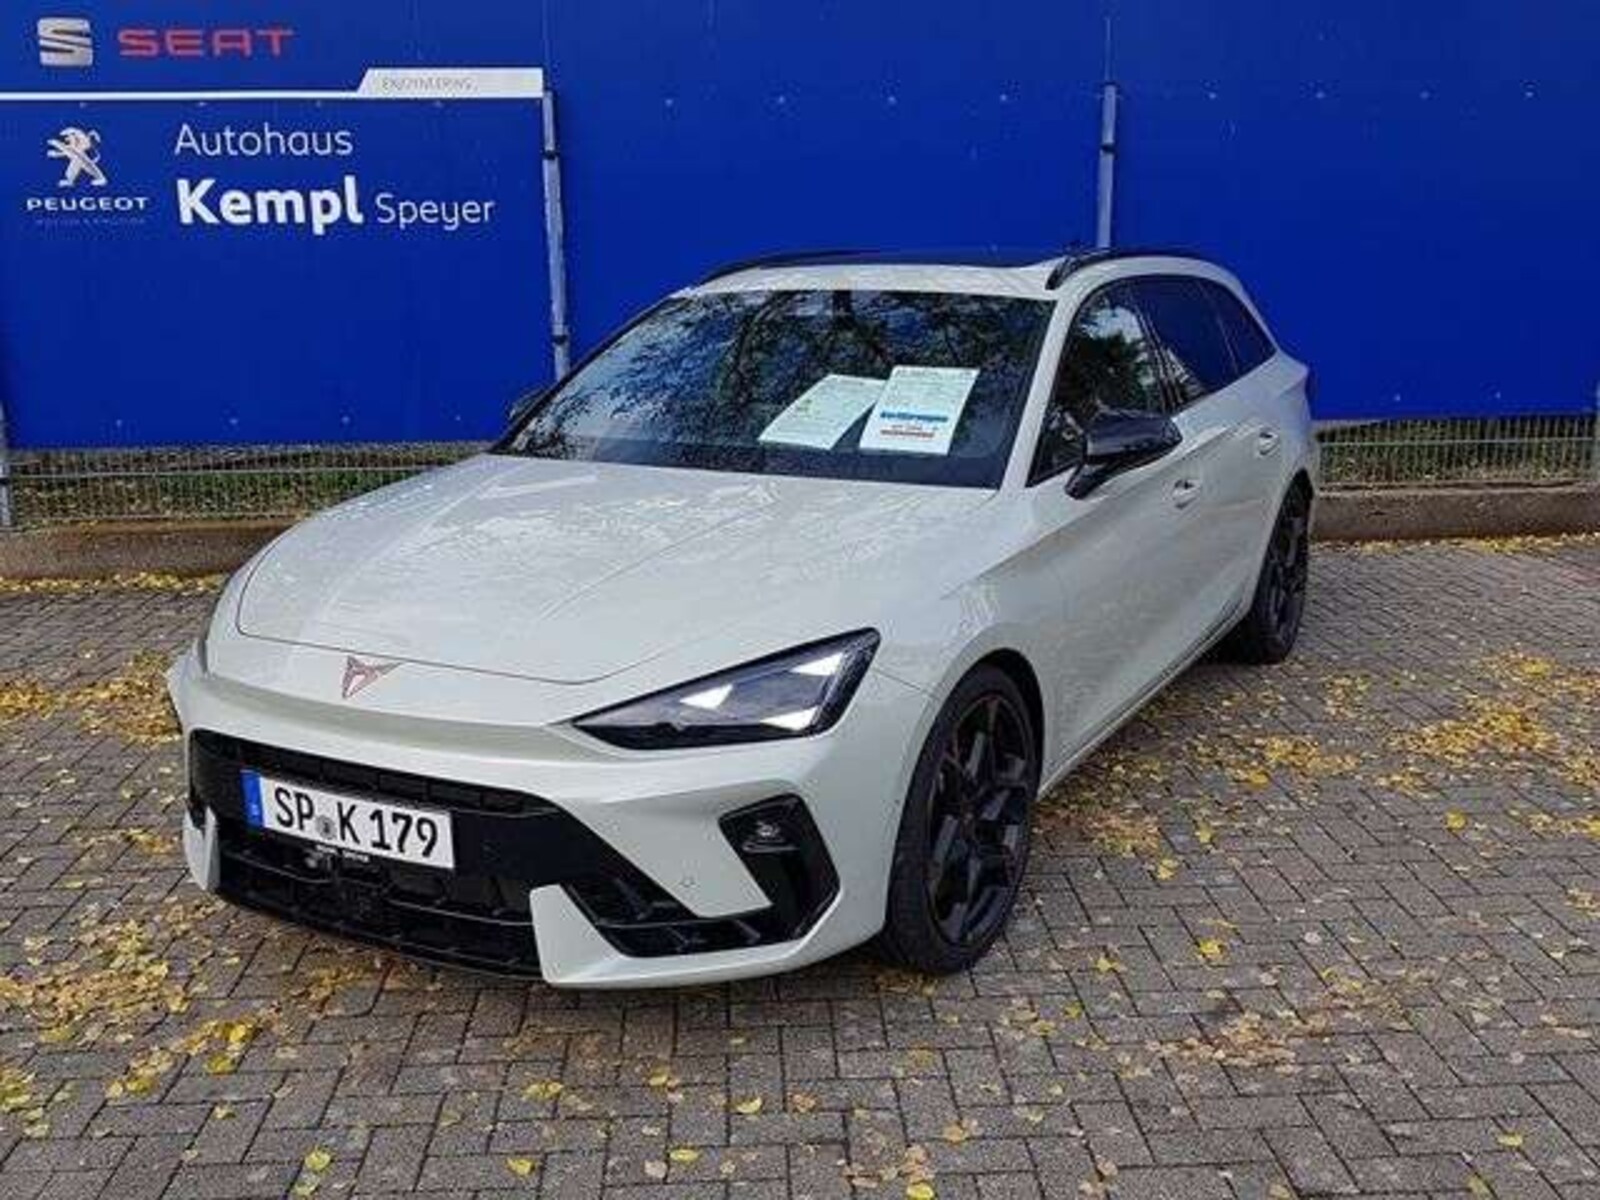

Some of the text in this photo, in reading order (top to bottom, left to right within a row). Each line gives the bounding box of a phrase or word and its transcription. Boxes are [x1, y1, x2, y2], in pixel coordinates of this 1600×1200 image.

[117, 28, 295, 57] SEAT
[175, 121, 355, 156] Autohaus
[26, 196, 149, 211] PEUGEOT
[176, 174, 496, 236] Kempl Speyer
[274, 787, 439, 858] SP K 179
